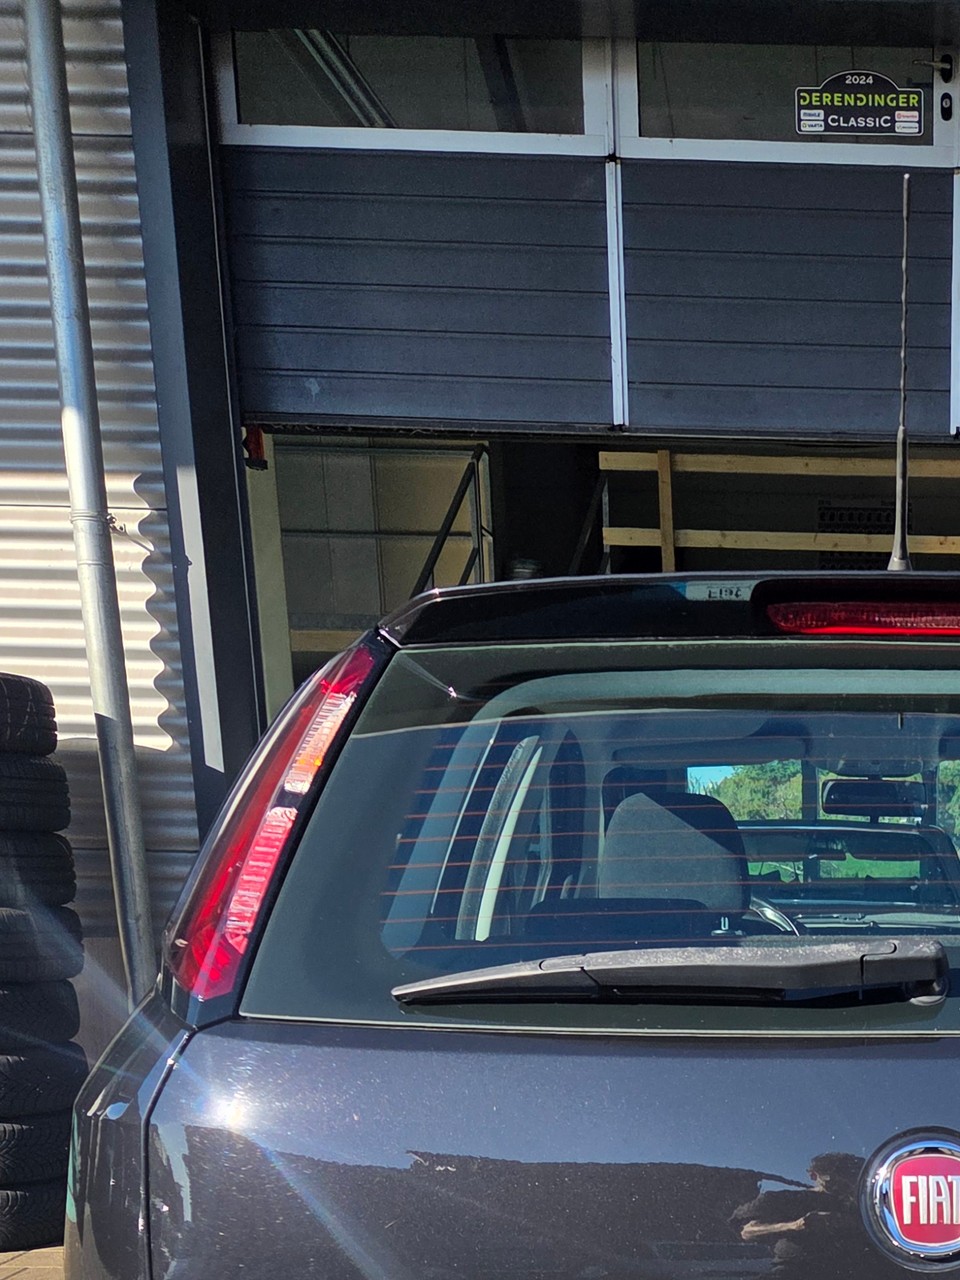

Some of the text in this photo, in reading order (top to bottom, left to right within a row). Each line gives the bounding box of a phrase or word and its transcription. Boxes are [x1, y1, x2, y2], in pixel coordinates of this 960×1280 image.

[845, 75, 874, 85] 2024
[800, 92, 919, 107] DERENDINGER
[827, 115, 892, 127] CLASSIC
